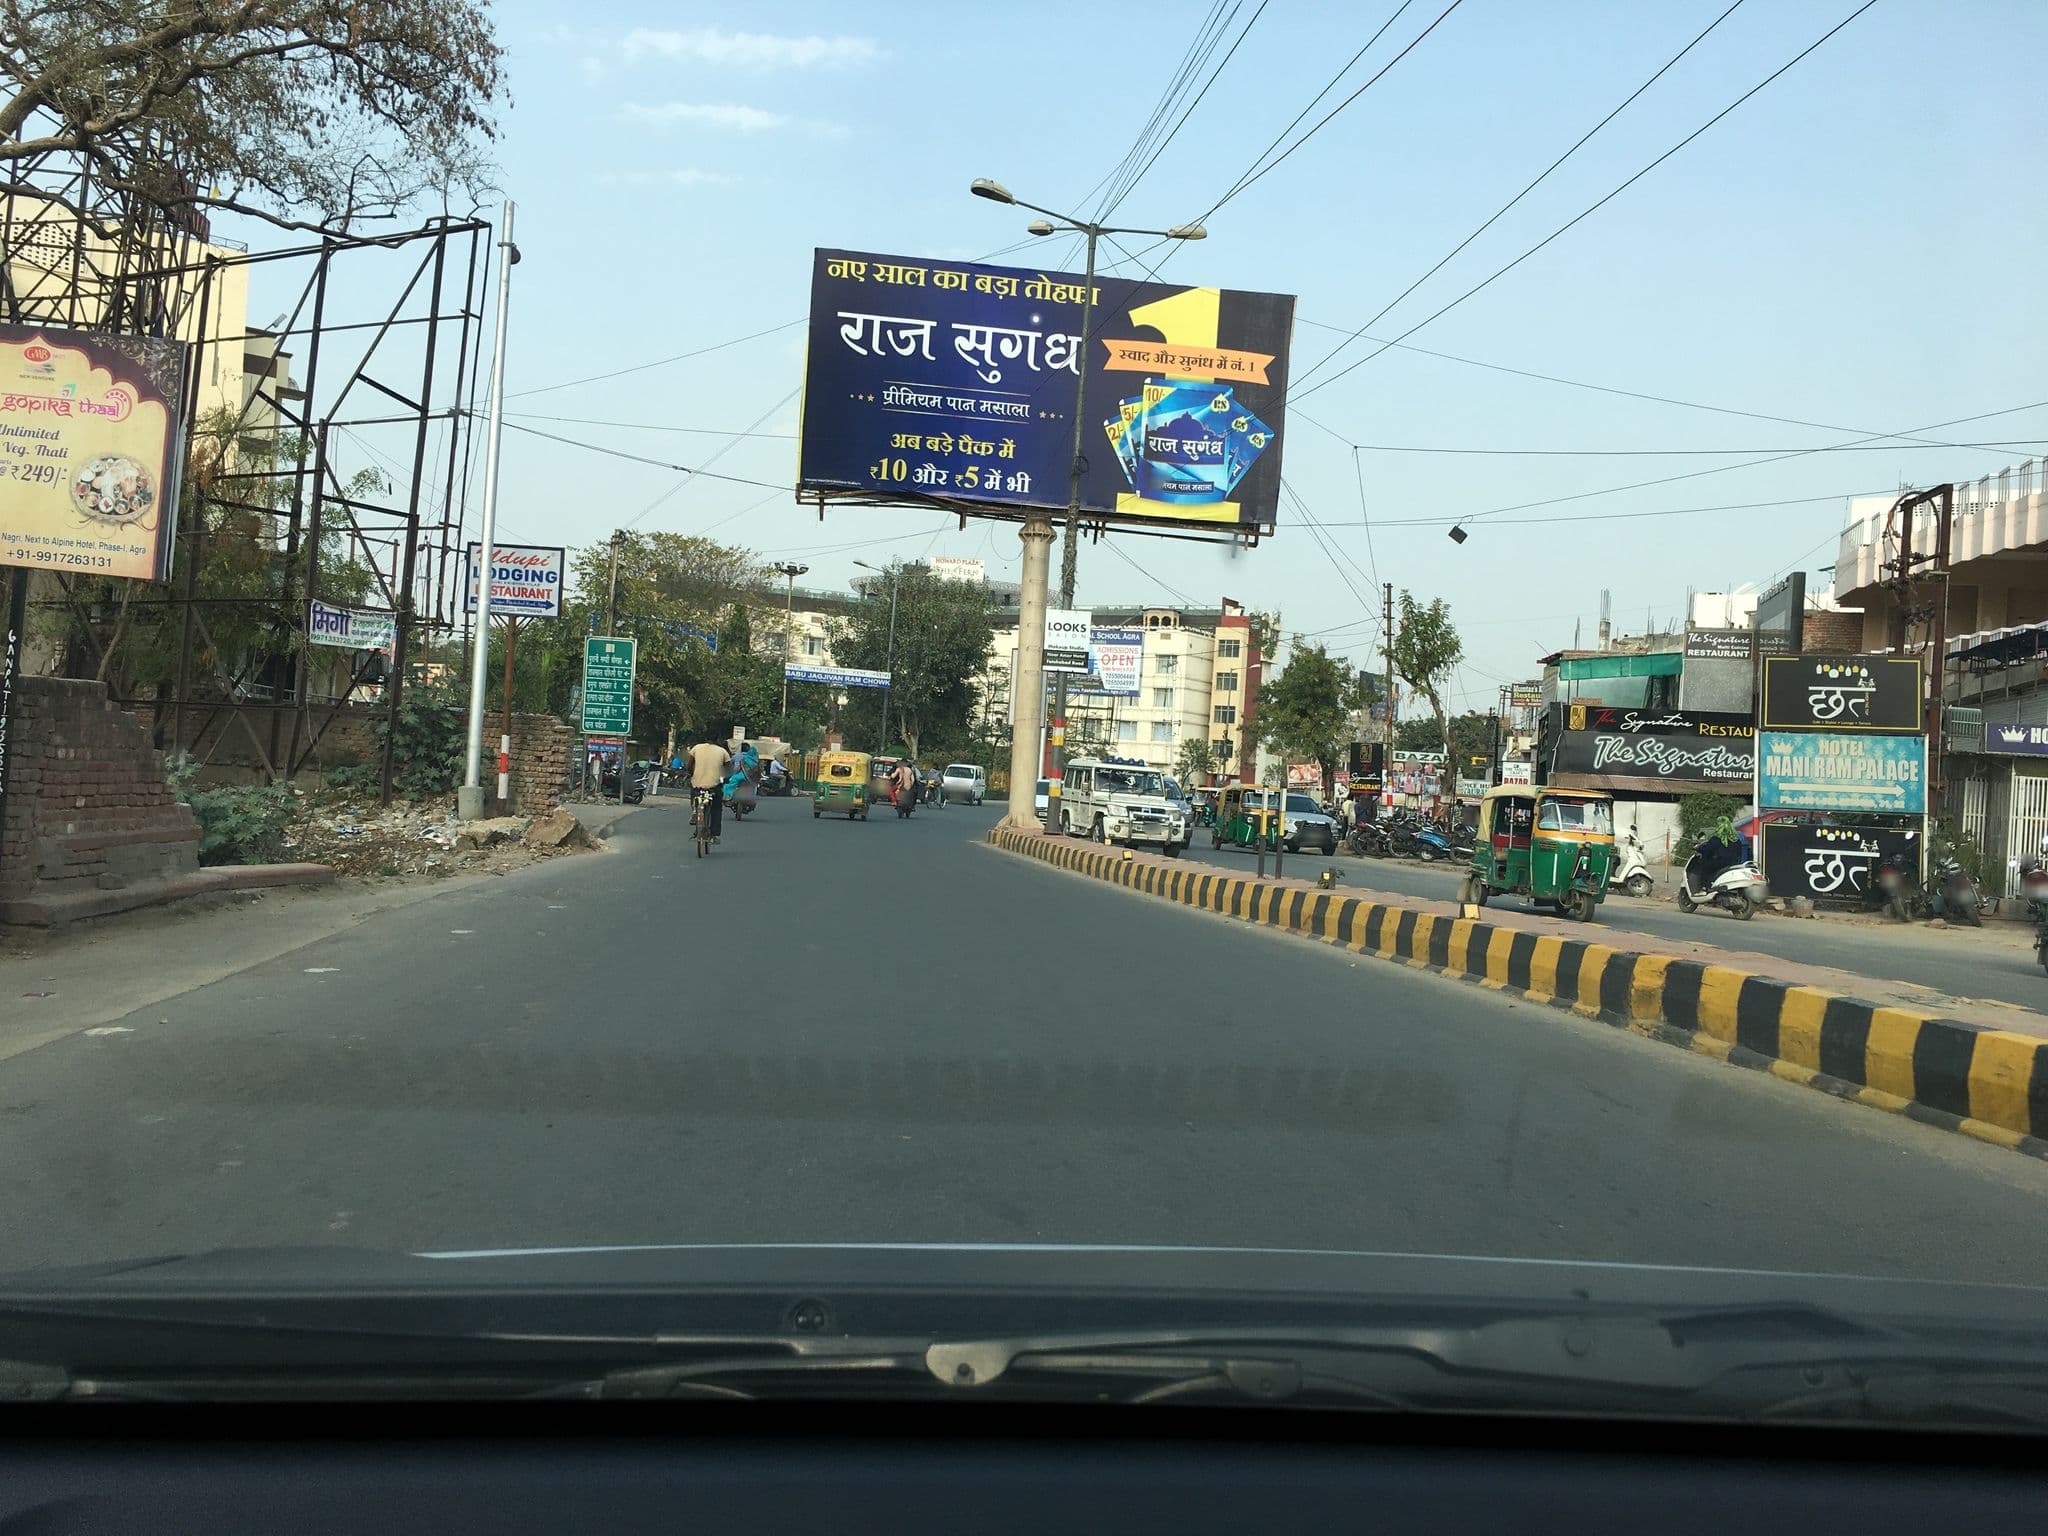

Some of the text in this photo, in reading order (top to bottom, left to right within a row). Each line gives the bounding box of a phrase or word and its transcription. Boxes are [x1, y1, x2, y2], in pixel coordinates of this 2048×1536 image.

[827, 258, 868, 283] नए
[872, 262, 928, 288] साल
[933, 269, 970, 292] का
[974, 273, 1020, 300] बड़ा
[837, 311, 1084, 384] राज सुगंध
[1119, 349, 1151, 363] स्वाद
[1153, 350, 1177, 366] और
[1179, 354, 1214, 372] सुगंध
[1216, 356, 1229, 371] में
[882, 386, 1031, 419] प्रीमियम पान मसाला
[2, 441, 69, 459] Veg. Thali
[889, 432, 1016, 459] अब बड़े पैक में
[1148, 435, 1224, 461] राज सुगंध
[869, 457, 1033, 494] ₹10 और ₹5 में भी
[25, 535, 41, 545] Next
[42, 537, 50, 545] to
[52, 538, 74, 549] Alpine
[129, 545, 147, 556] Agra
[474, 583, 553, 600] STAURANT
[1047, 621, 1087, 633] LOOKS
[1687, 632, 1702, 645] The
[1703, 632, 1751, 646] Signature
[1101, 654, 1135, 667] OPEN
[1687, 649, 1750, 658] RESTAURANT
[785, 670, 807, 678] BABU
[807, 672, 845, 682] JAGJIVAN
[845, 676, 862, 684] RAM
[862, 678, 891, 686] CHOWK
[1620, 711, 1694, 733] Signature
[1594, 736, 1754, 774] The Signatur
[1818, 739, 1865, 758] HOTEL
[1766, 756, 1919, 782] MANI RAM PALACE
